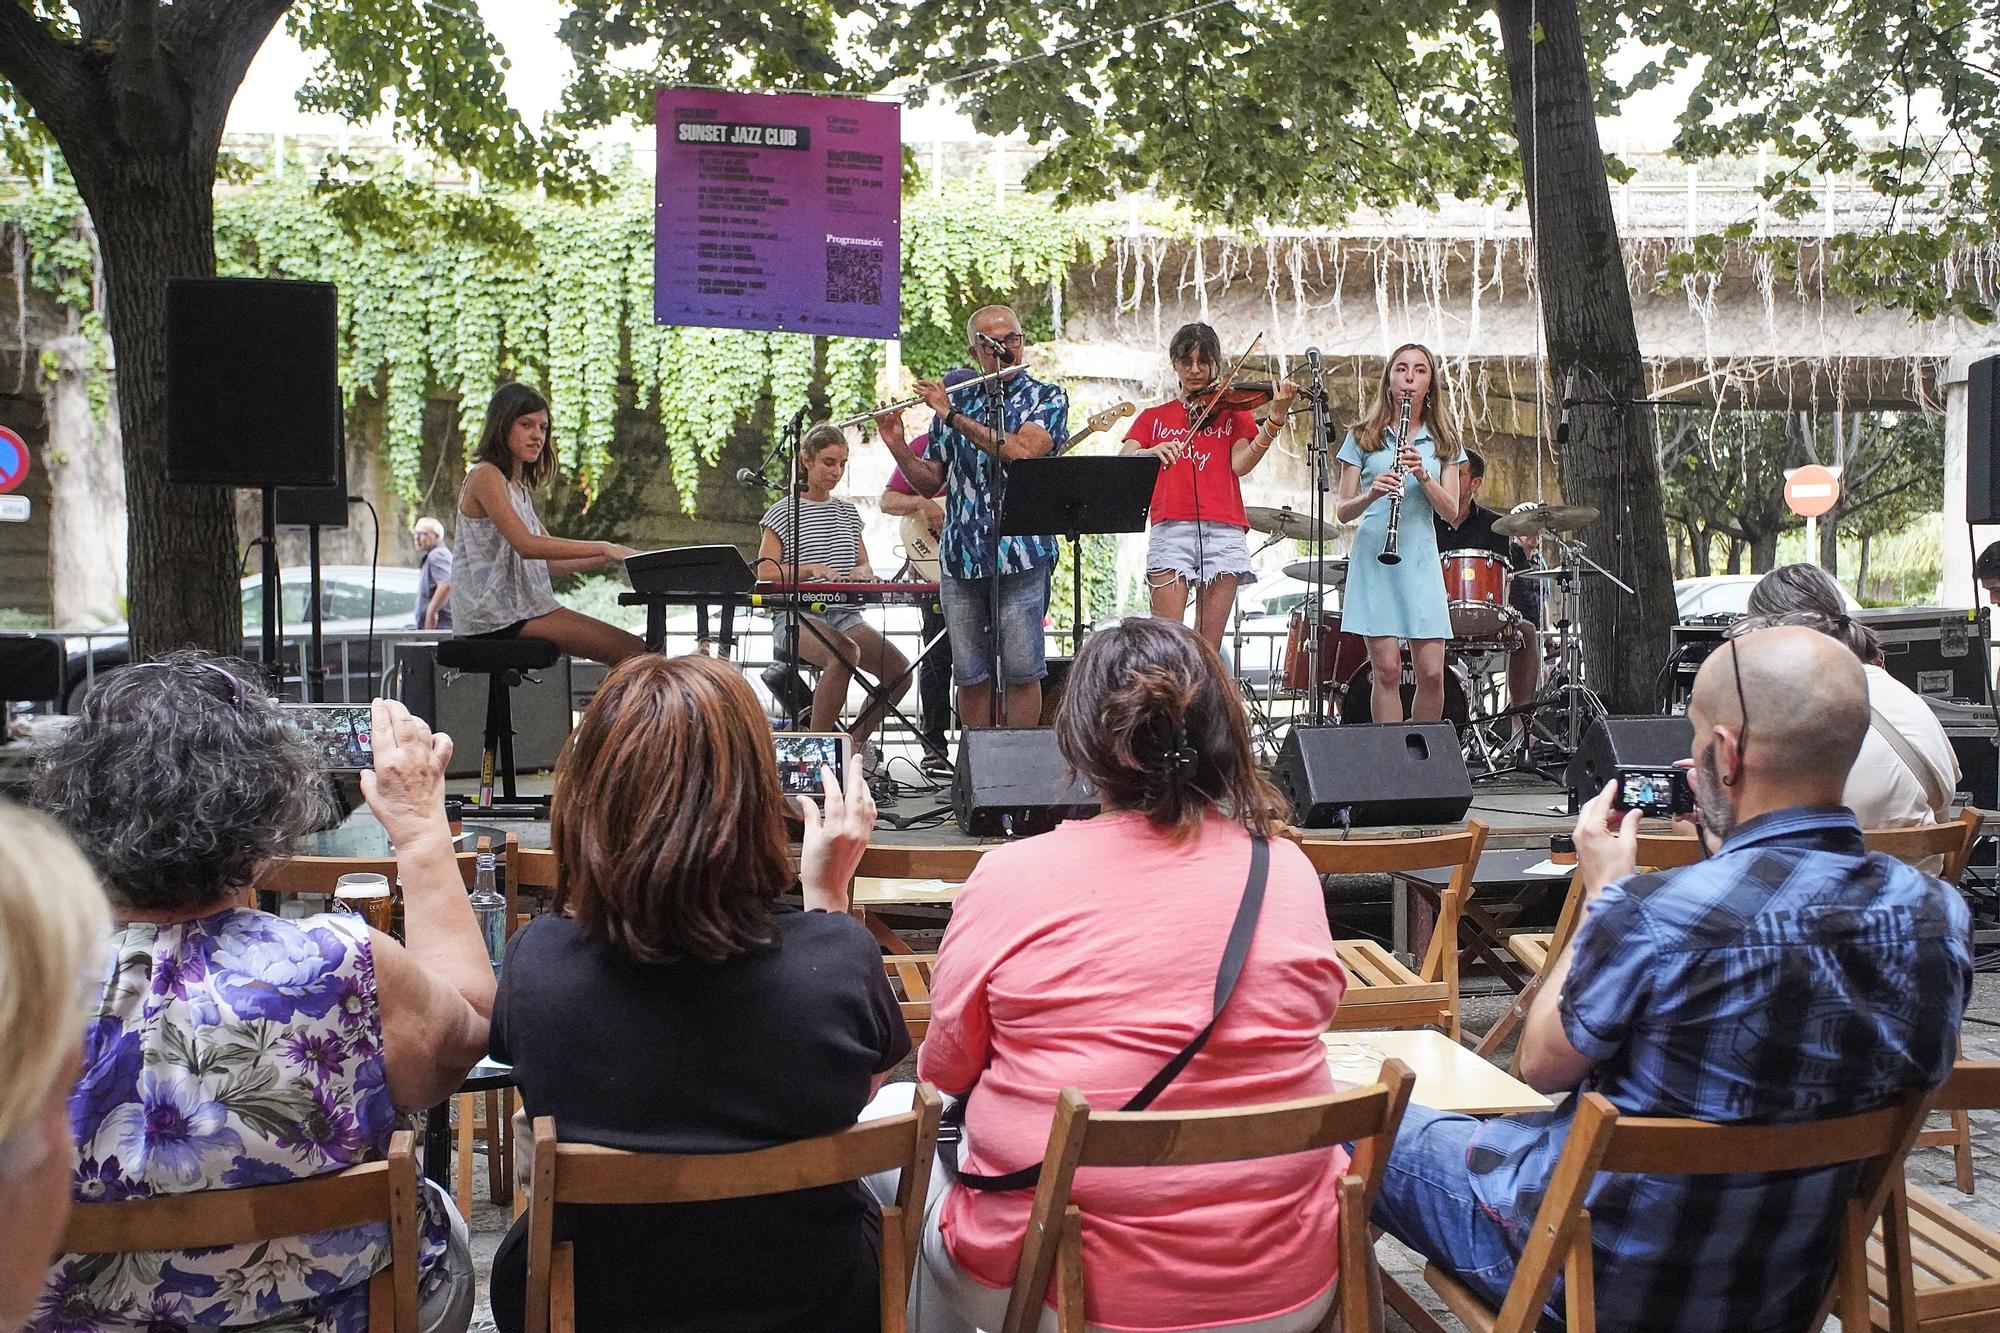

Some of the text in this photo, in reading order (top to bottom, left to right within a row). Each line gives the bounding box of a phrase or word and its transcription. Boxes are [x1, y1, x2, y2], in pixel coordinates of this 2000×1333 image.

[678, 123, 797, 146] SUNSET JAZZ CLUB
[1152, 417, 1233, 440] New ork
